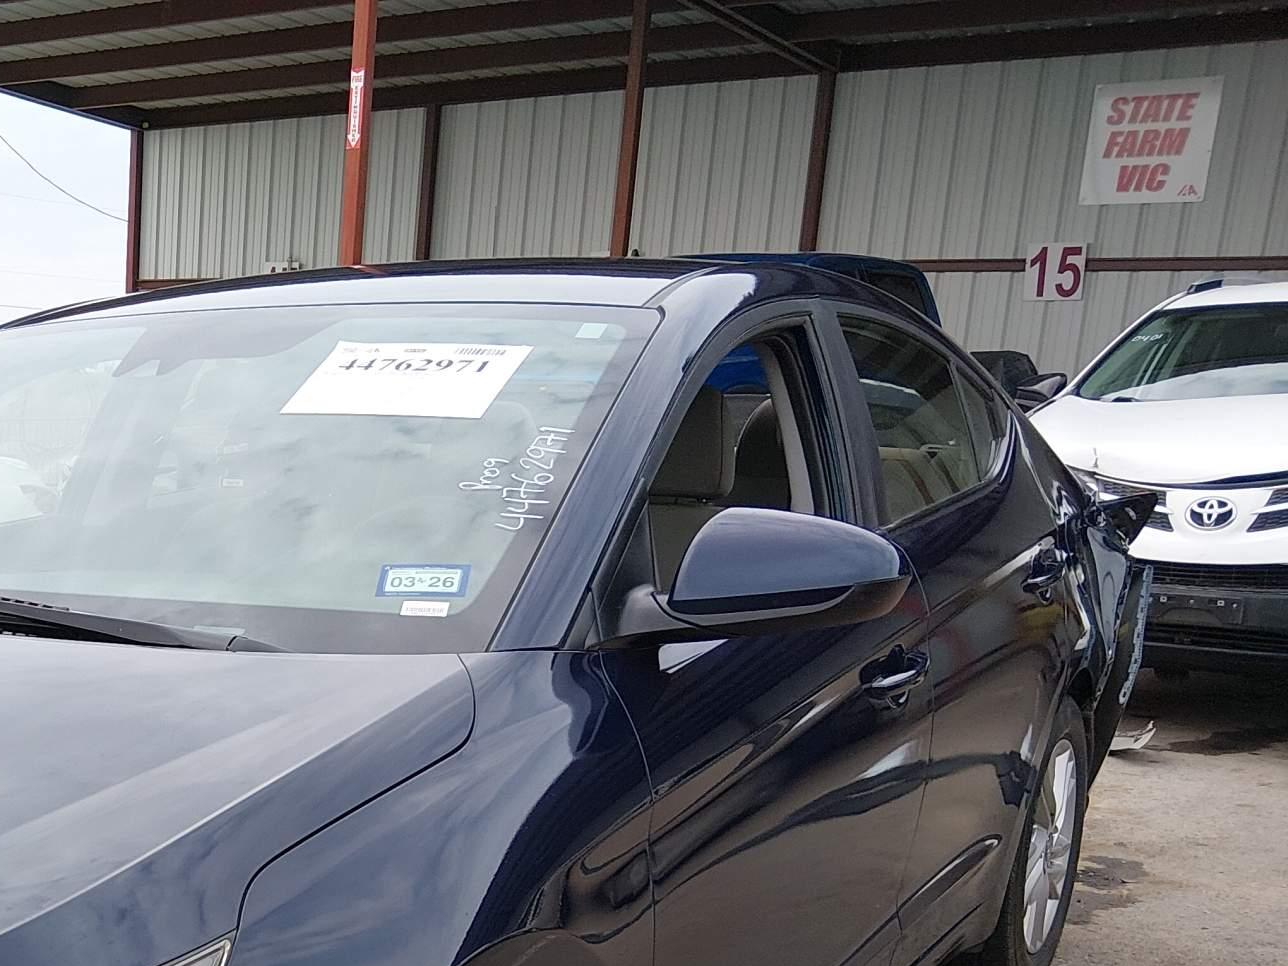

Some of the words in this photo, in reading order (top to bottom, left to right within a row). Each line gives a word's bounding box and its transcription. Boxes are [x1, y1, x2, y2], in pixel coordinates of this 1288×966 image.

[1106, 92, 1201, 125] STATE
[1102, 127, 1192, 159] FARM
[1115, 163, 1171, 193] VIC
[1029, 246, 1083, 298] 15
[338, 358, 490, 373] 44762971
[494, 425, 576, 532] 44762971
